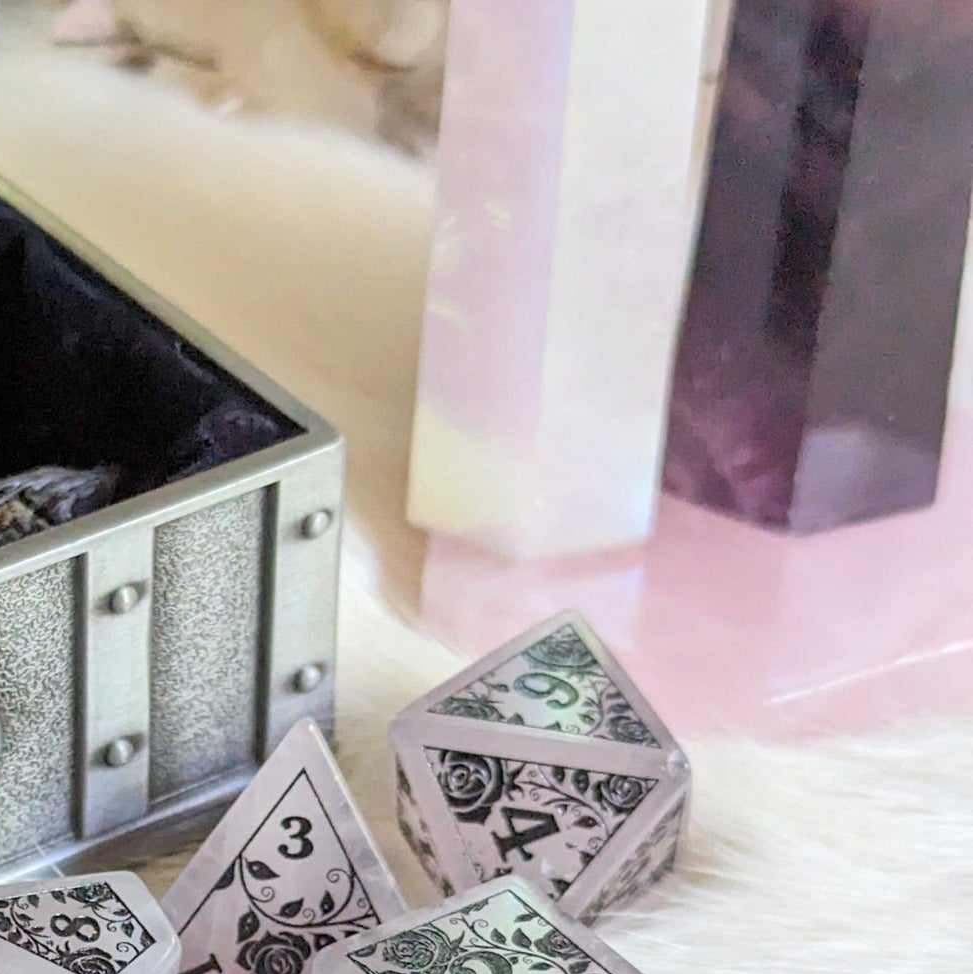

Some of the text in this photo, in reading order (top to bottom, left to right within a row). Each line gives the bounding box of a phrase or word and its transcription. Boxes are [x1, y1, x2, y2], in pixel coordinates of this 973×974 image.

[278, 816, 313, 859] 3
[490, 806, 560, 862] 4
[50, 914, 100, 942] 8
